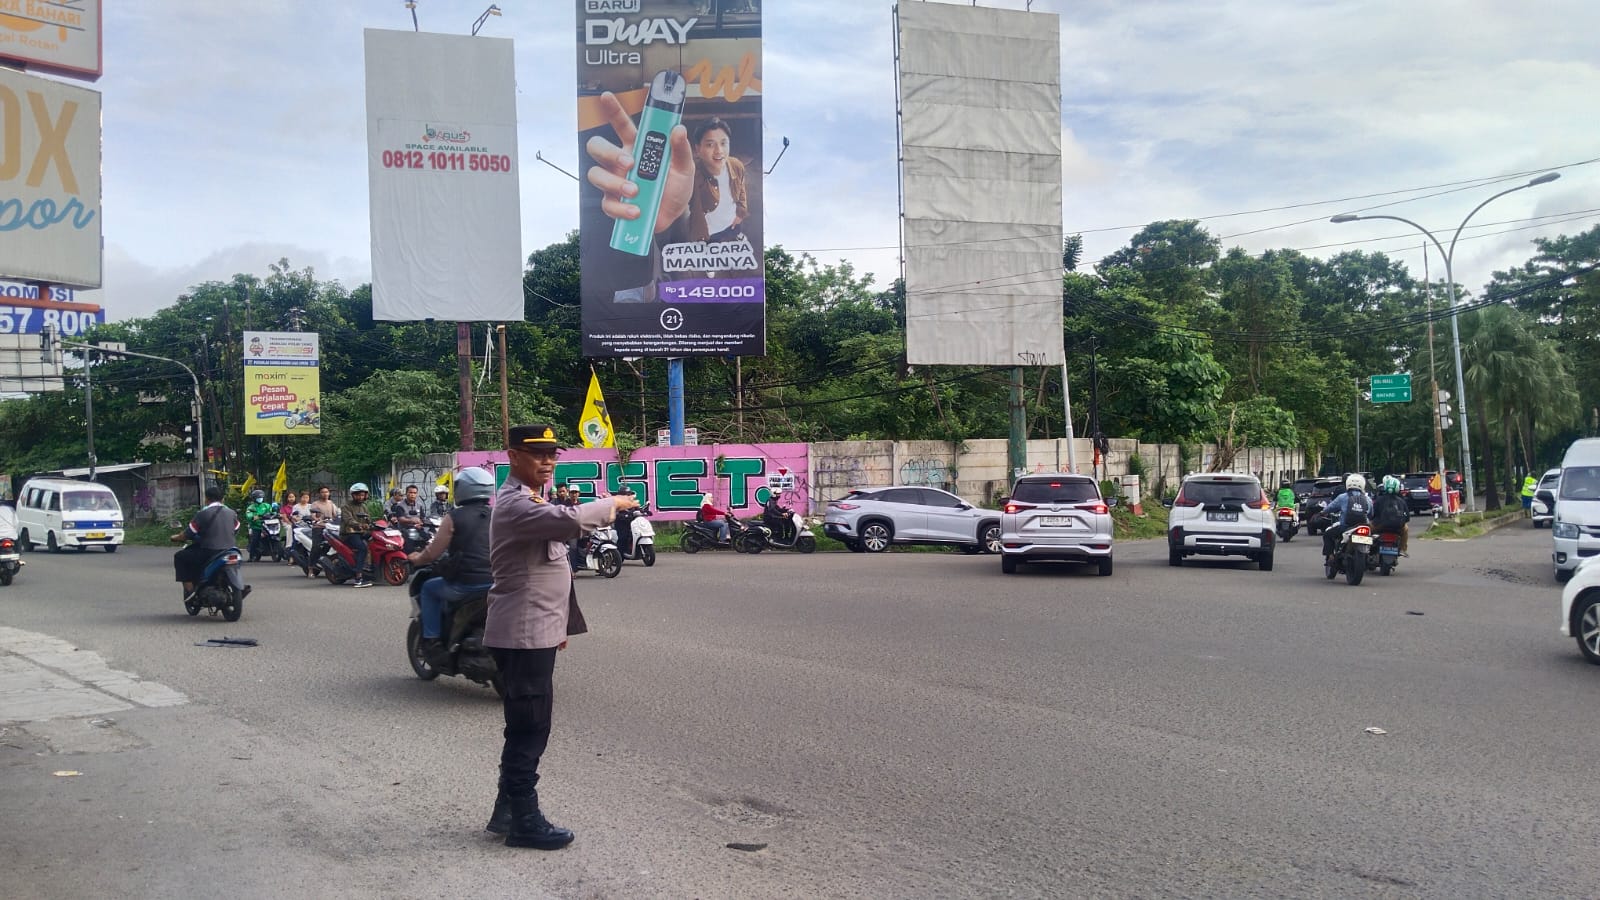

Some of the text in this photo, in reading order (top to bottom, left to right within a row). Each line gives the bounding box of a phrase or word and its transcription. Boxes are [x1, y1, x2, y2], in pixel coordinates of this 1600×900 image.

[588, 0, 637, 10] BARU!
[586, 50, 641, 65] Ultra
[405, 143, 488, 153] SPACE AVAILABLE
[382, 150, 511, 173] 0812 1011 5050
[665, 243, 751, 256] #TAU CARA
[666, 256, 755, 269] MAINNYA
[665, 285, 755, 298] Rp 149.000
[42, 308, 97, 336] 800
[255, 371, 287, 380] maxim
[251, 394, 295, 402] perjalanan
[494, 457, 770, 511] ESET.
